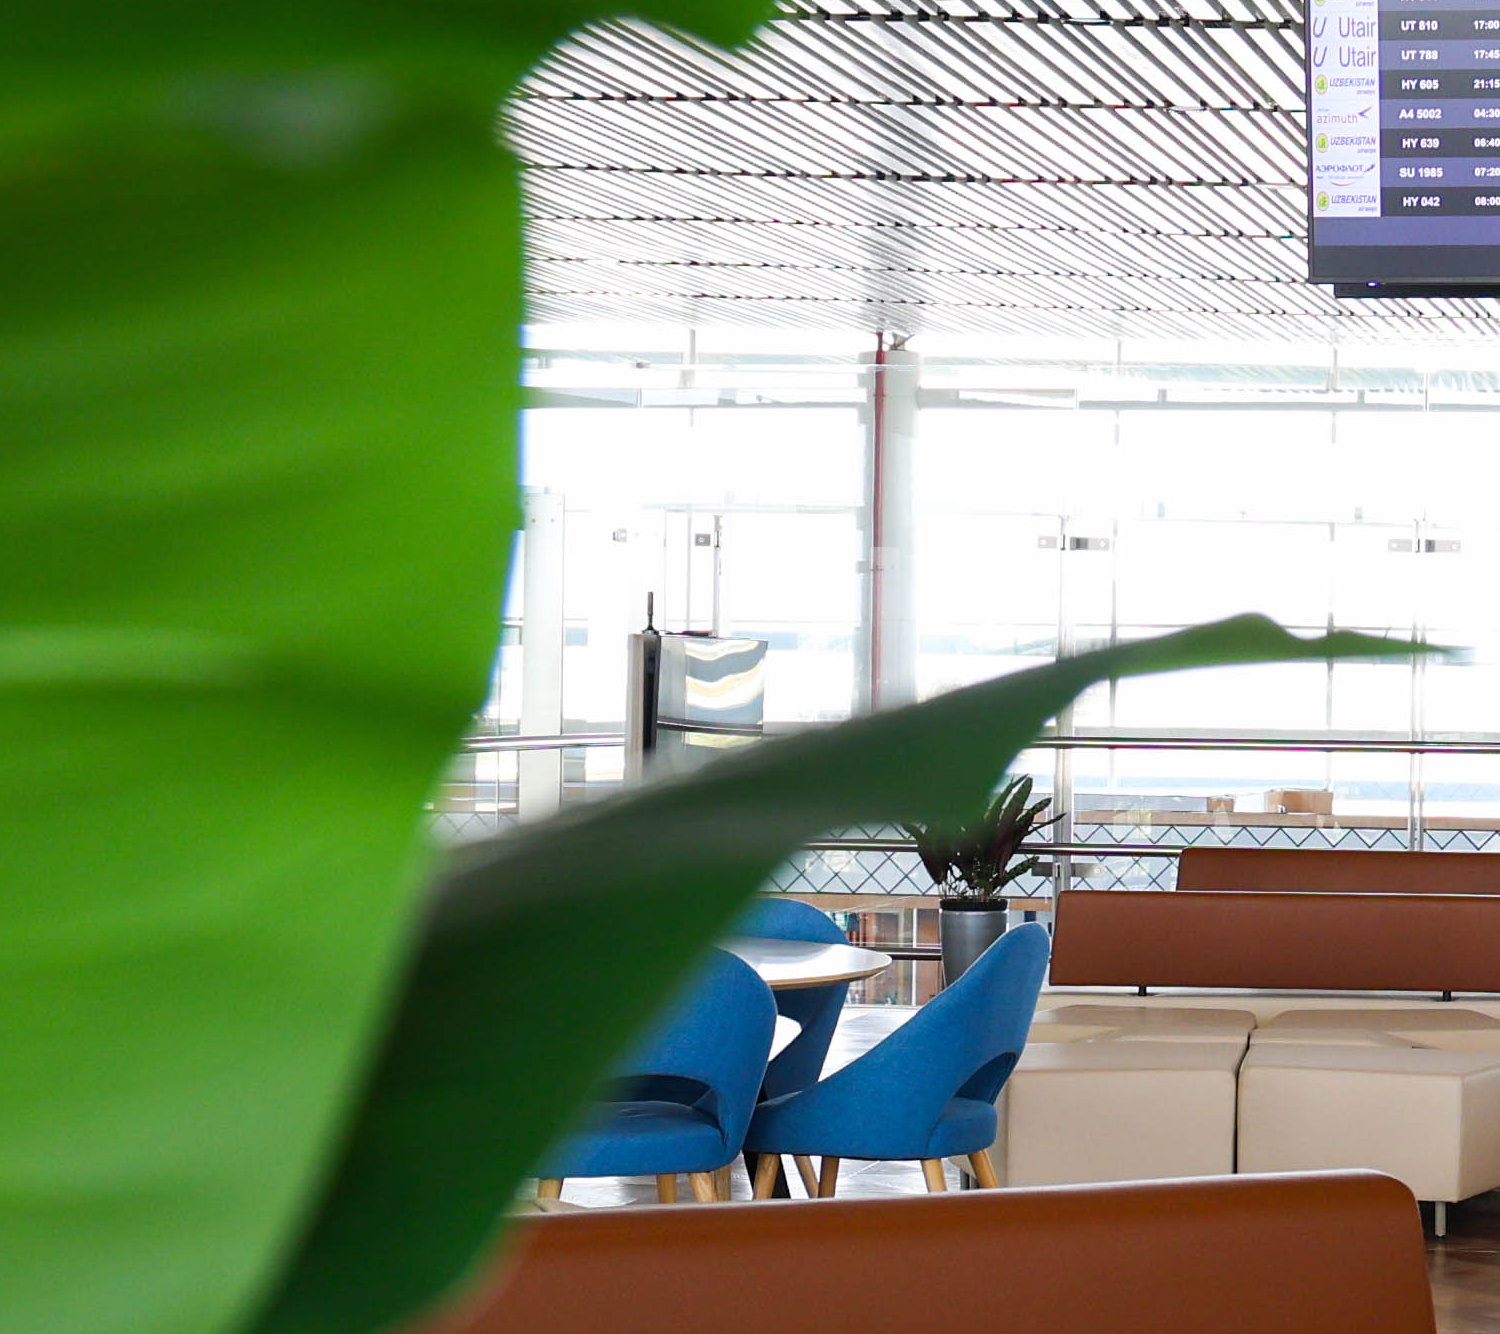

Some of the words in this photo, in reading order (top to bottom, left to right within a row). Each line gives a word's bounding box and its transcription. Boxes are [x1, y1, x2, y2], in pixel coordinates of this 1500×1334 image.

[1339, 17, 1376, 38] Utair
[1400, 21, 1416, 31] UT
[1419, 21, 1438, 31] 810
[1473, 20, 1500, 30] 17:00
[1339, 45, 1377, 68] Utair
[1401, 49, 1416, 60] UT
[1418, 49, 1439, 60] 788
[1473, 49, 1500, 59] 17:45
[1329, 77, 1376, 88] UZBEKISTAN
[1401, 79, 1418, 90] HY
[1419, 79, 1439, 90] 605
[1473, 79, 1500, 89] 21:15
[1316, 112, 1359, 124] azimuth
[1399, 109, 1414, 119] A4
[1416, 109, 1442, 119] 5002
[1474, 109, 1500, 119] 04:30
[1330, 136, 1376, 146] UZBEKISTAN
[1402, 138, 1419, 149] HY
[1420, 138, 1440, 149] 639
[1474, 138, 1500, 148] 06:40
[1315, 164, 1364, 173] АЭРОФЛОТ
[1399, 167, 1416, 178] SU
[1418, 167, 1443, 178] 1985
[1474, 167, 1500, 177] 07:20
[1331, 195, 1377, 204] UZBEKISTAN
[1403, 197, 1419, 207] HY
[1420, 197, 1441, 207] 042
